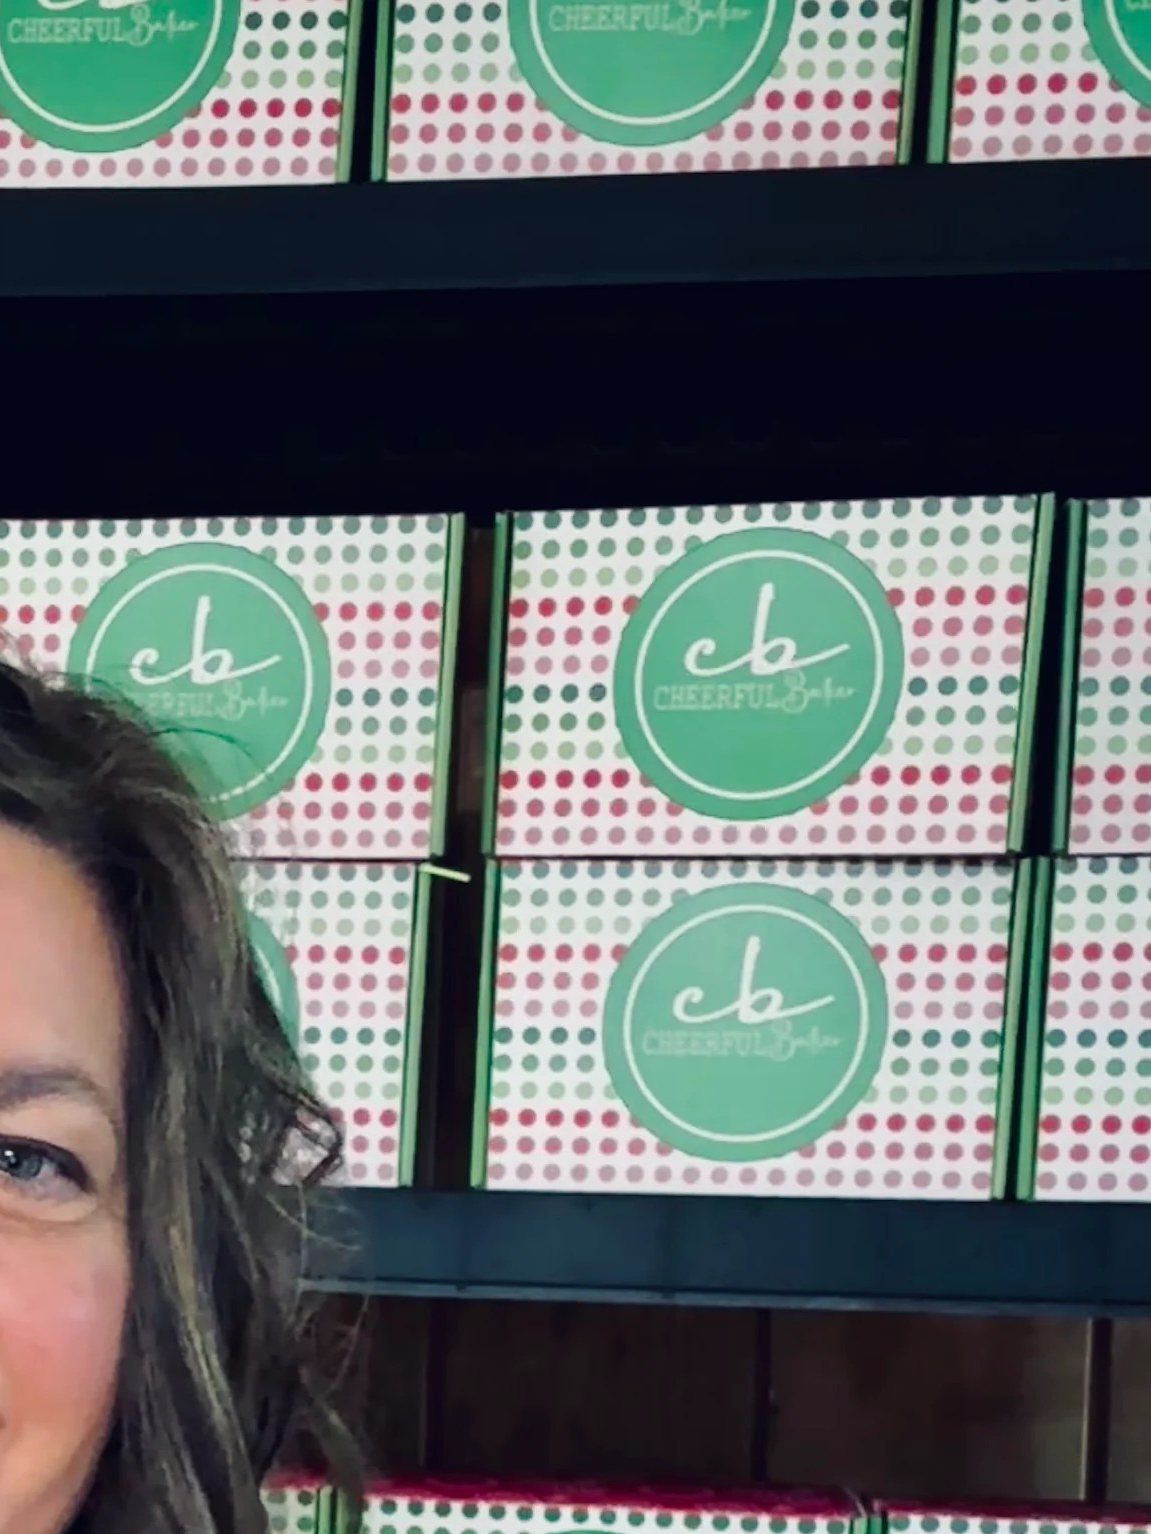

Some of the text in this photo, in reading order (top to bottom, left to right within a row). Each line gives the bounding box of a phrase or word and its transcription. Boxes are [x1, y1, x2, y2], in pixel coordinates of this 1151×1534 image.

[7, 17, 129, 43] CHEERFUL
[550, 4, 676, 31] CHEERFUL
[129, 595, 281, 685] cb
[684, 582, 850, 676] cb
[653, 682, 780, 711] CHEERFUL
[672, 936, 835, 1024] cb
